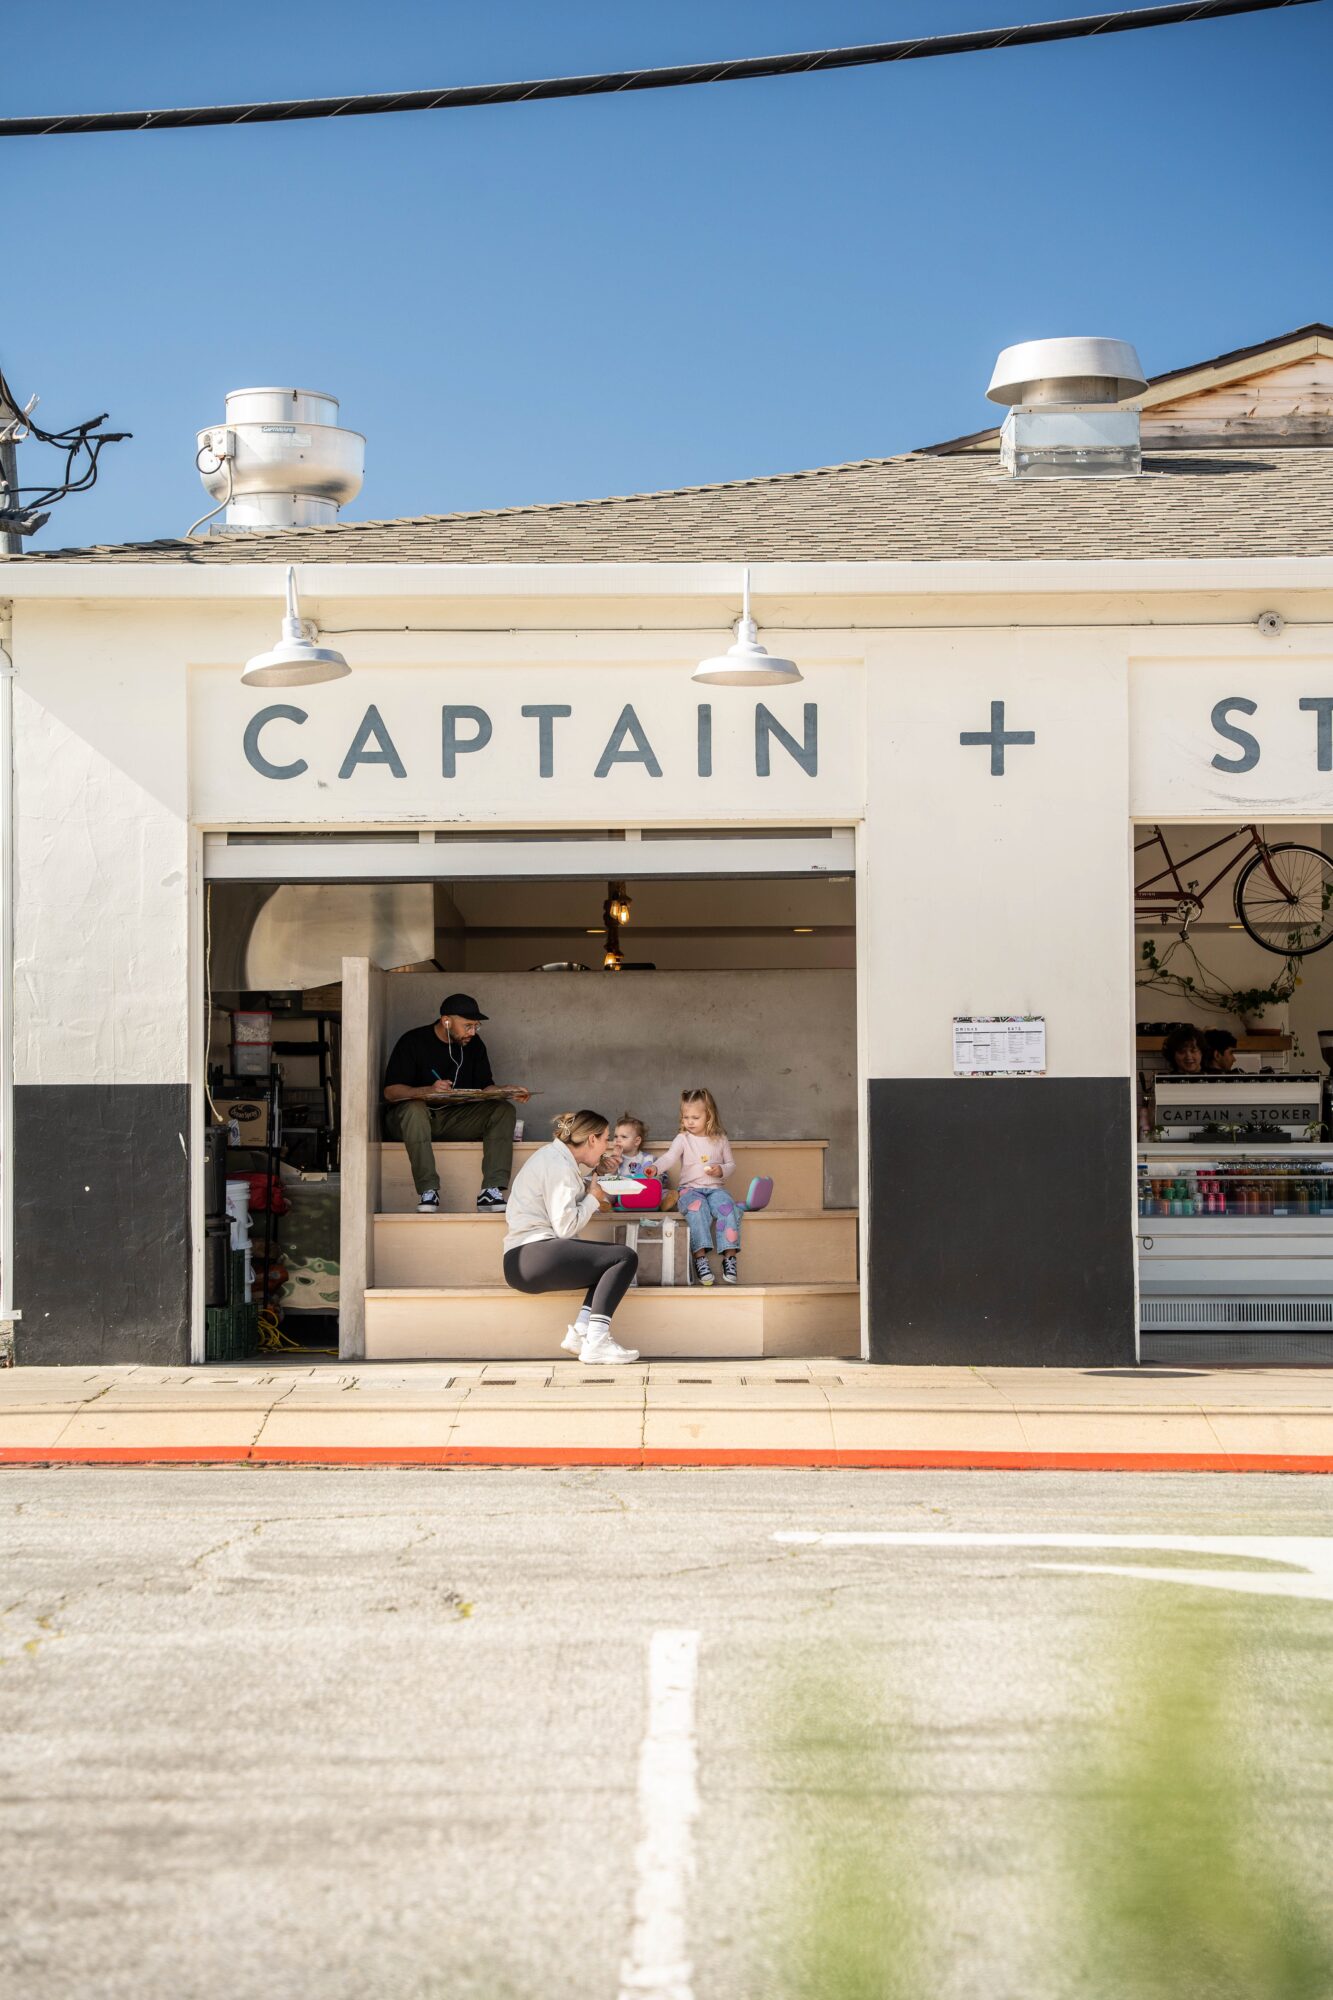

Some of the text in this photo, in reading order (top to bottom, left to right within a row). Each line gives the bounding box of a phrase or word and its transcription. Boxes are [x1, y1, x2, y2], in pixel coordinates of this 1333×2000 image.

[243, 696, 1333, 780] CAPTAIN + ST
[1162, 1109, 1230, 1121] CAPTAIN
[1250, 1109, 1312, 1120] STOKER
